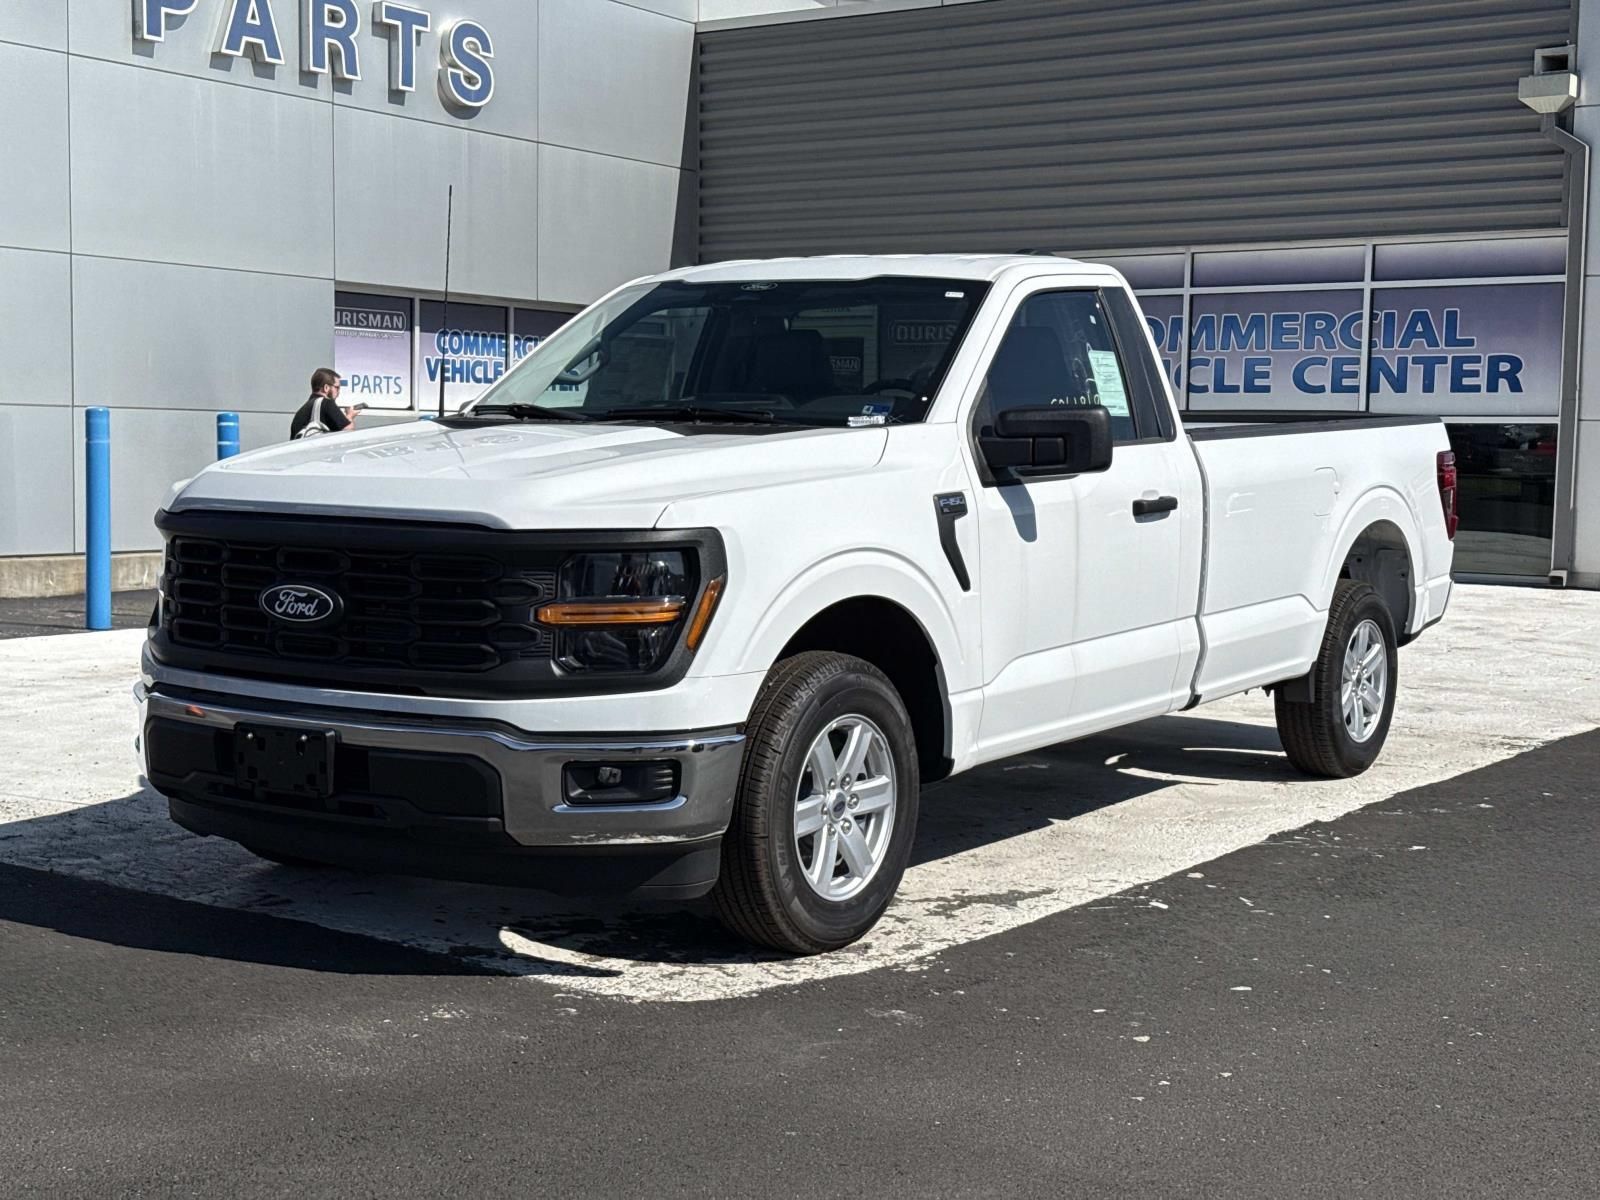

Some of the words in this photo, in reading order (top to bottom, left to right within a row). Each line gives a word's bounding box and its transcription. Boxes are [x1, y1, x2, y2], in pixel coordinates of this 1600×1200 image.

[351, 374, 402, 395] PARTS
[1292, 354, 1523, 394] CENTER
[274, 589, 319, 616] Ford
